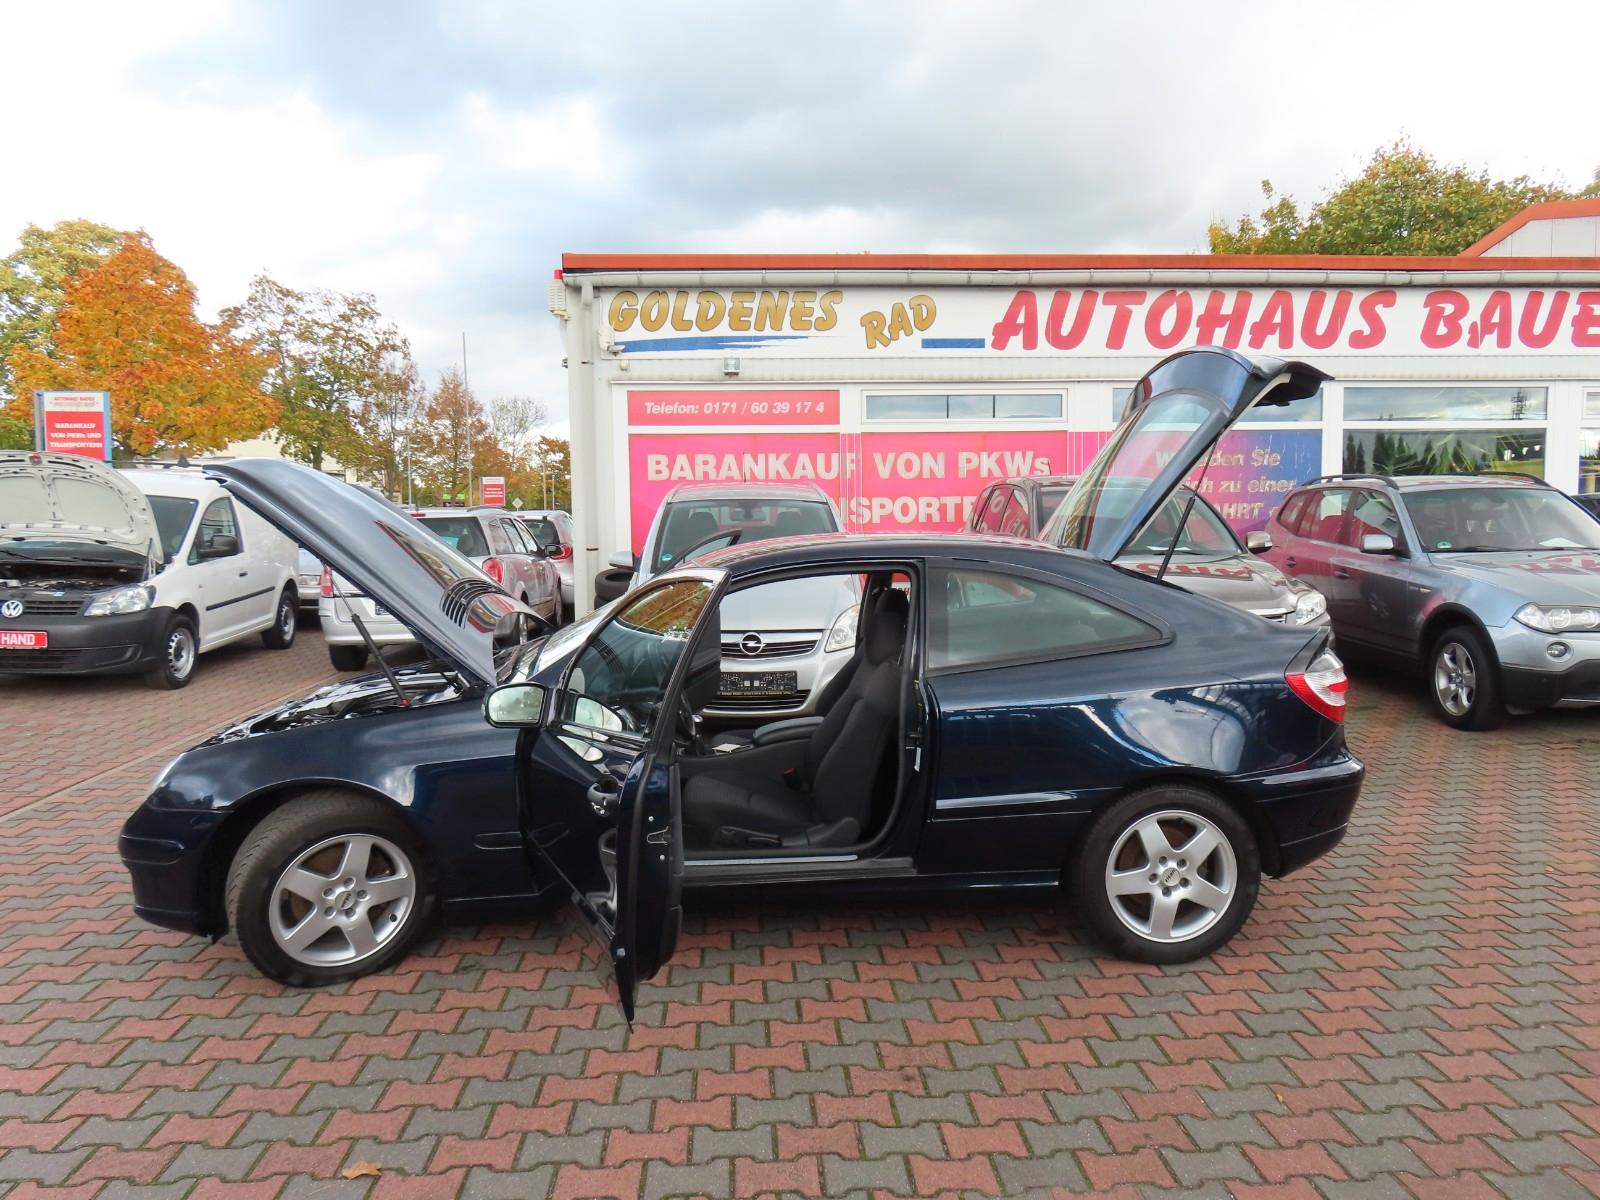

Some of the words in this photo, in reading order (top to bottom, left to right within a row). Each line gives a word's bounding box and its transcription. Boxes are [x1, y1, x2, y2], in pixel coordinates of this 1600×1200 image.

[608, 290, 843, 332] GOLDENES
[860, 294, 937, 349] RAD
[990, 289, 1398, 351] AUTOHAUS
[644, 402, 699, 415] Telefon:
[703, 402, 737, 414] 0171
[750, 402, 769, 414] 60
[772, 402, 791, 414] 39
[795, 402, 813, 414] 17
[815, 402, 826, 414] 4
[647, 452, 860, 481] BARANKAUF
[873, 451, 945, 479] VON
[958, 451, 1051, 478] PKWs
[1251, 447, 1280, 467] Sie
[1218, 481, 1241, 493] zu
[1247, 477, 1297, 493] einer
[1, 633, 36, 646] HAND
